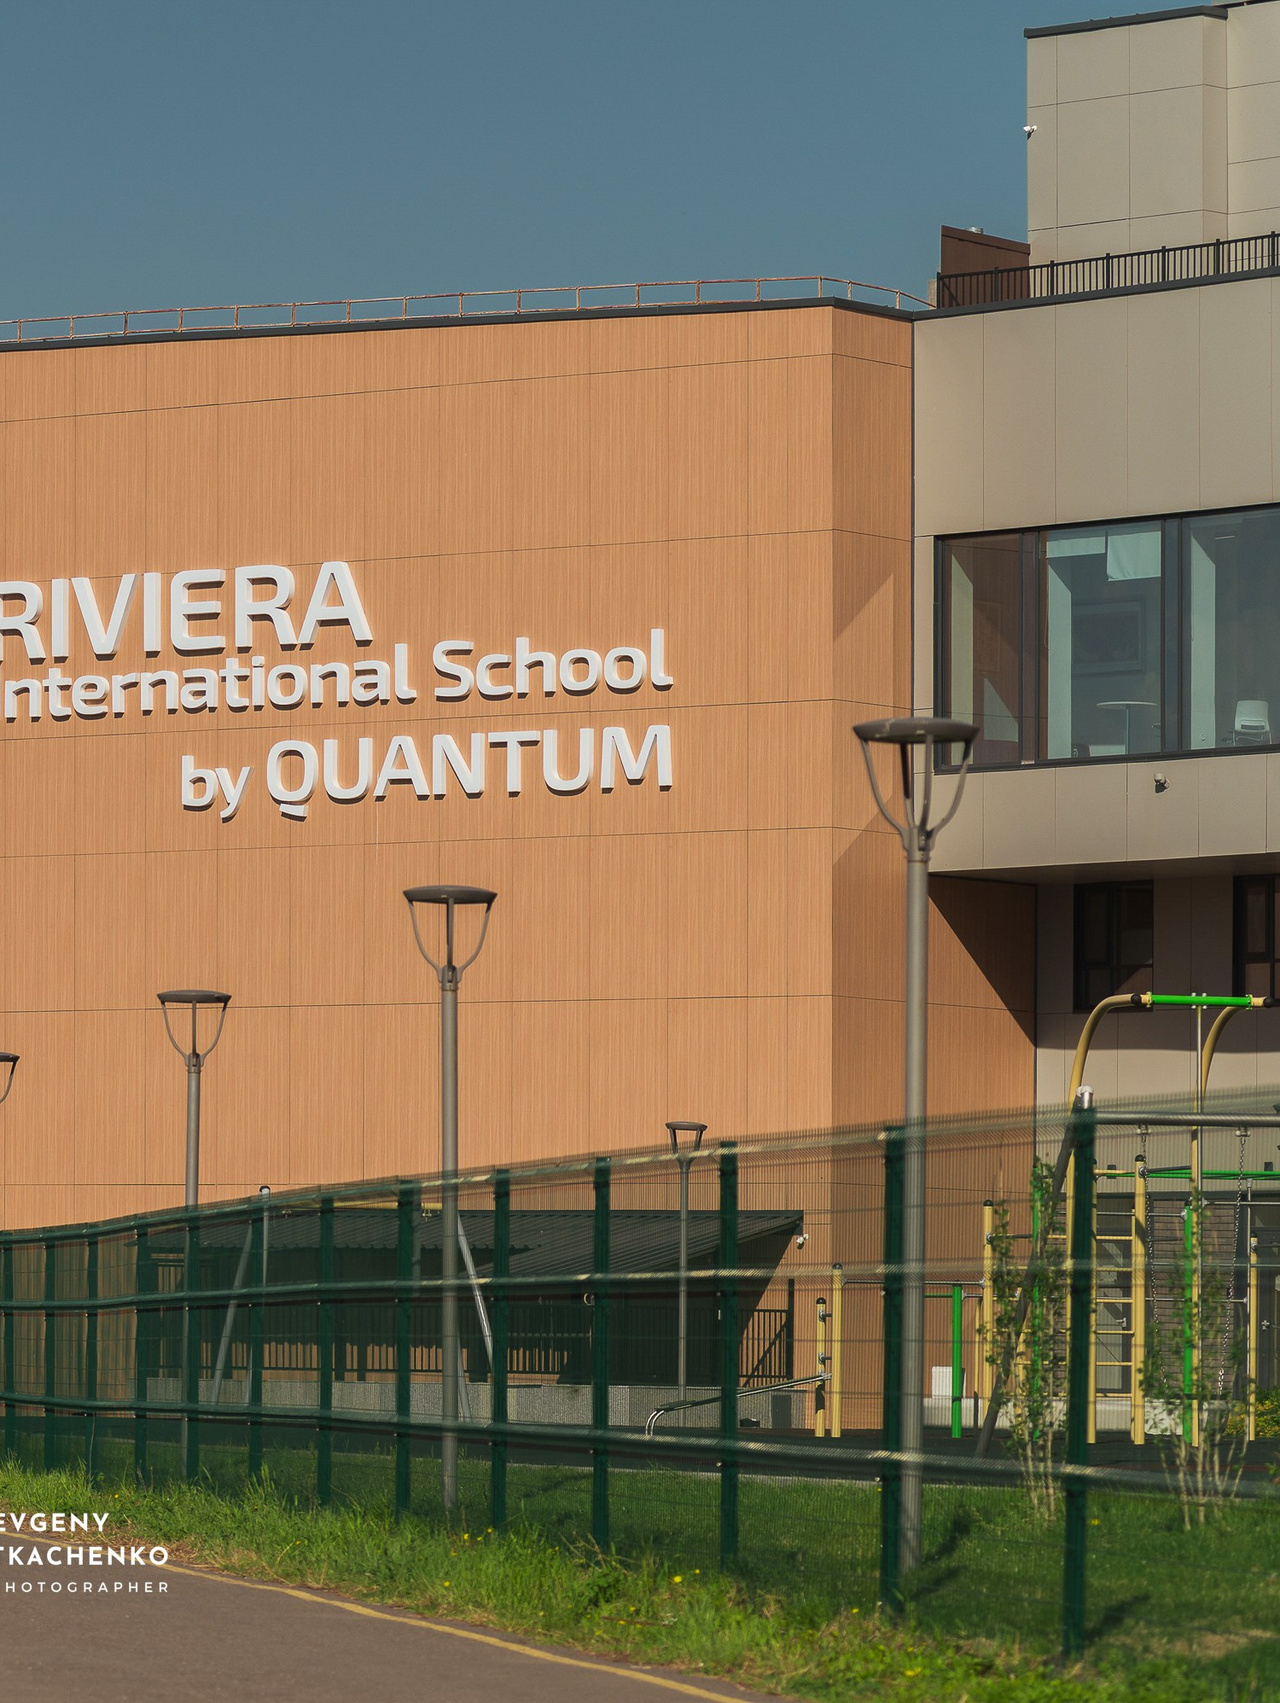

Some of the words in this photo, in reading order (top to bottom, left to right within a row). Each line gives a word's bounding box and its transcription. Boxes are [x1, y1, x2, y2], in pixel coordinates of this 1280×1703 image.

[433, 628, 673, 702] School
[181, 756, 252, 822] by
[267, 725, 673, 819] QUANTUM
